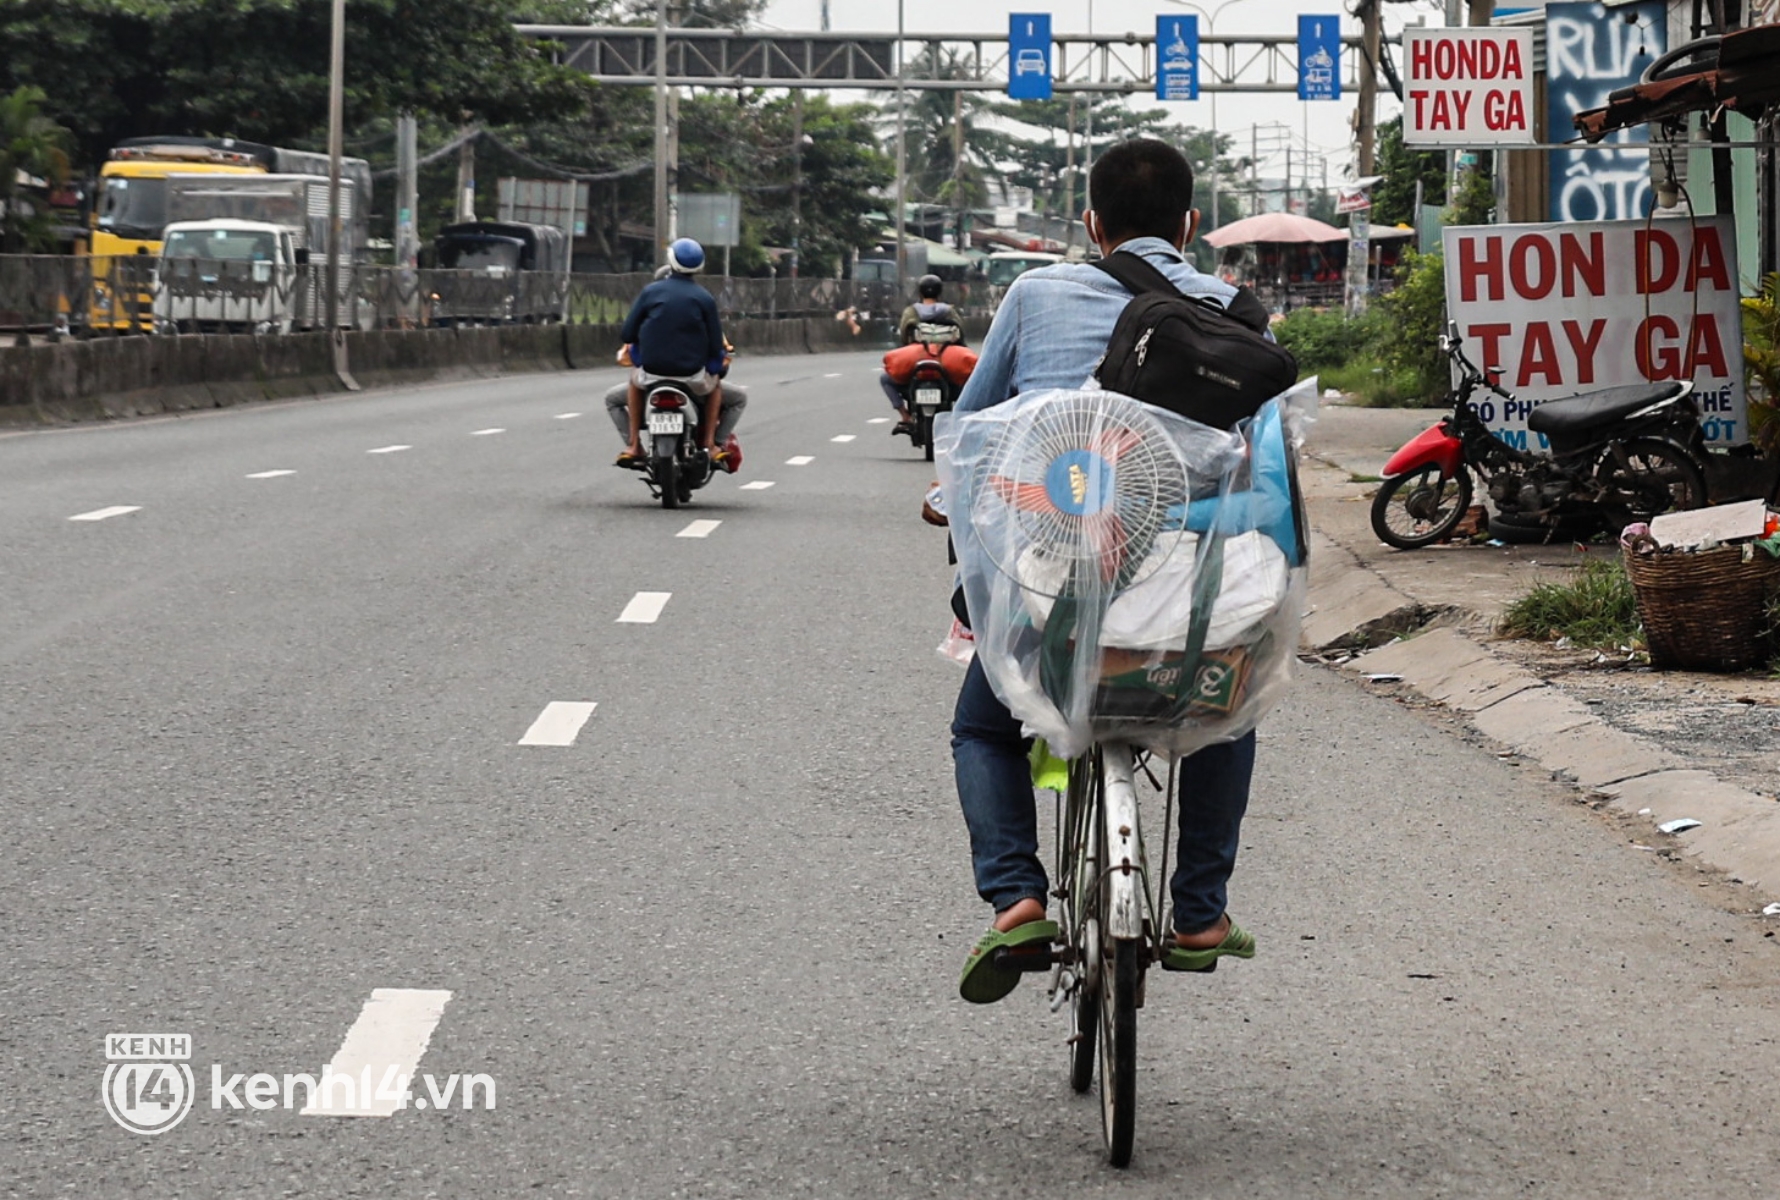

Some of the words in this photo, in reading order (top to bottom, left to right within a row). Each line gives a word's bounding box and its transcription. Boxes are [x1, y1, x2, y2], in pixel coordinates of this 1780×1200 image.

[1412, 39, 1523, 80] HONDA
[1409, 90, 1472, 130] TAY
[1484, 89, 1526, 131] GA
[1458, 231, 1605, 302] HON
[1634, 226, 1731, 294] DA
[1468, 318, 1607, 388] TAY
[1634, 313, 1728, 383] GA
